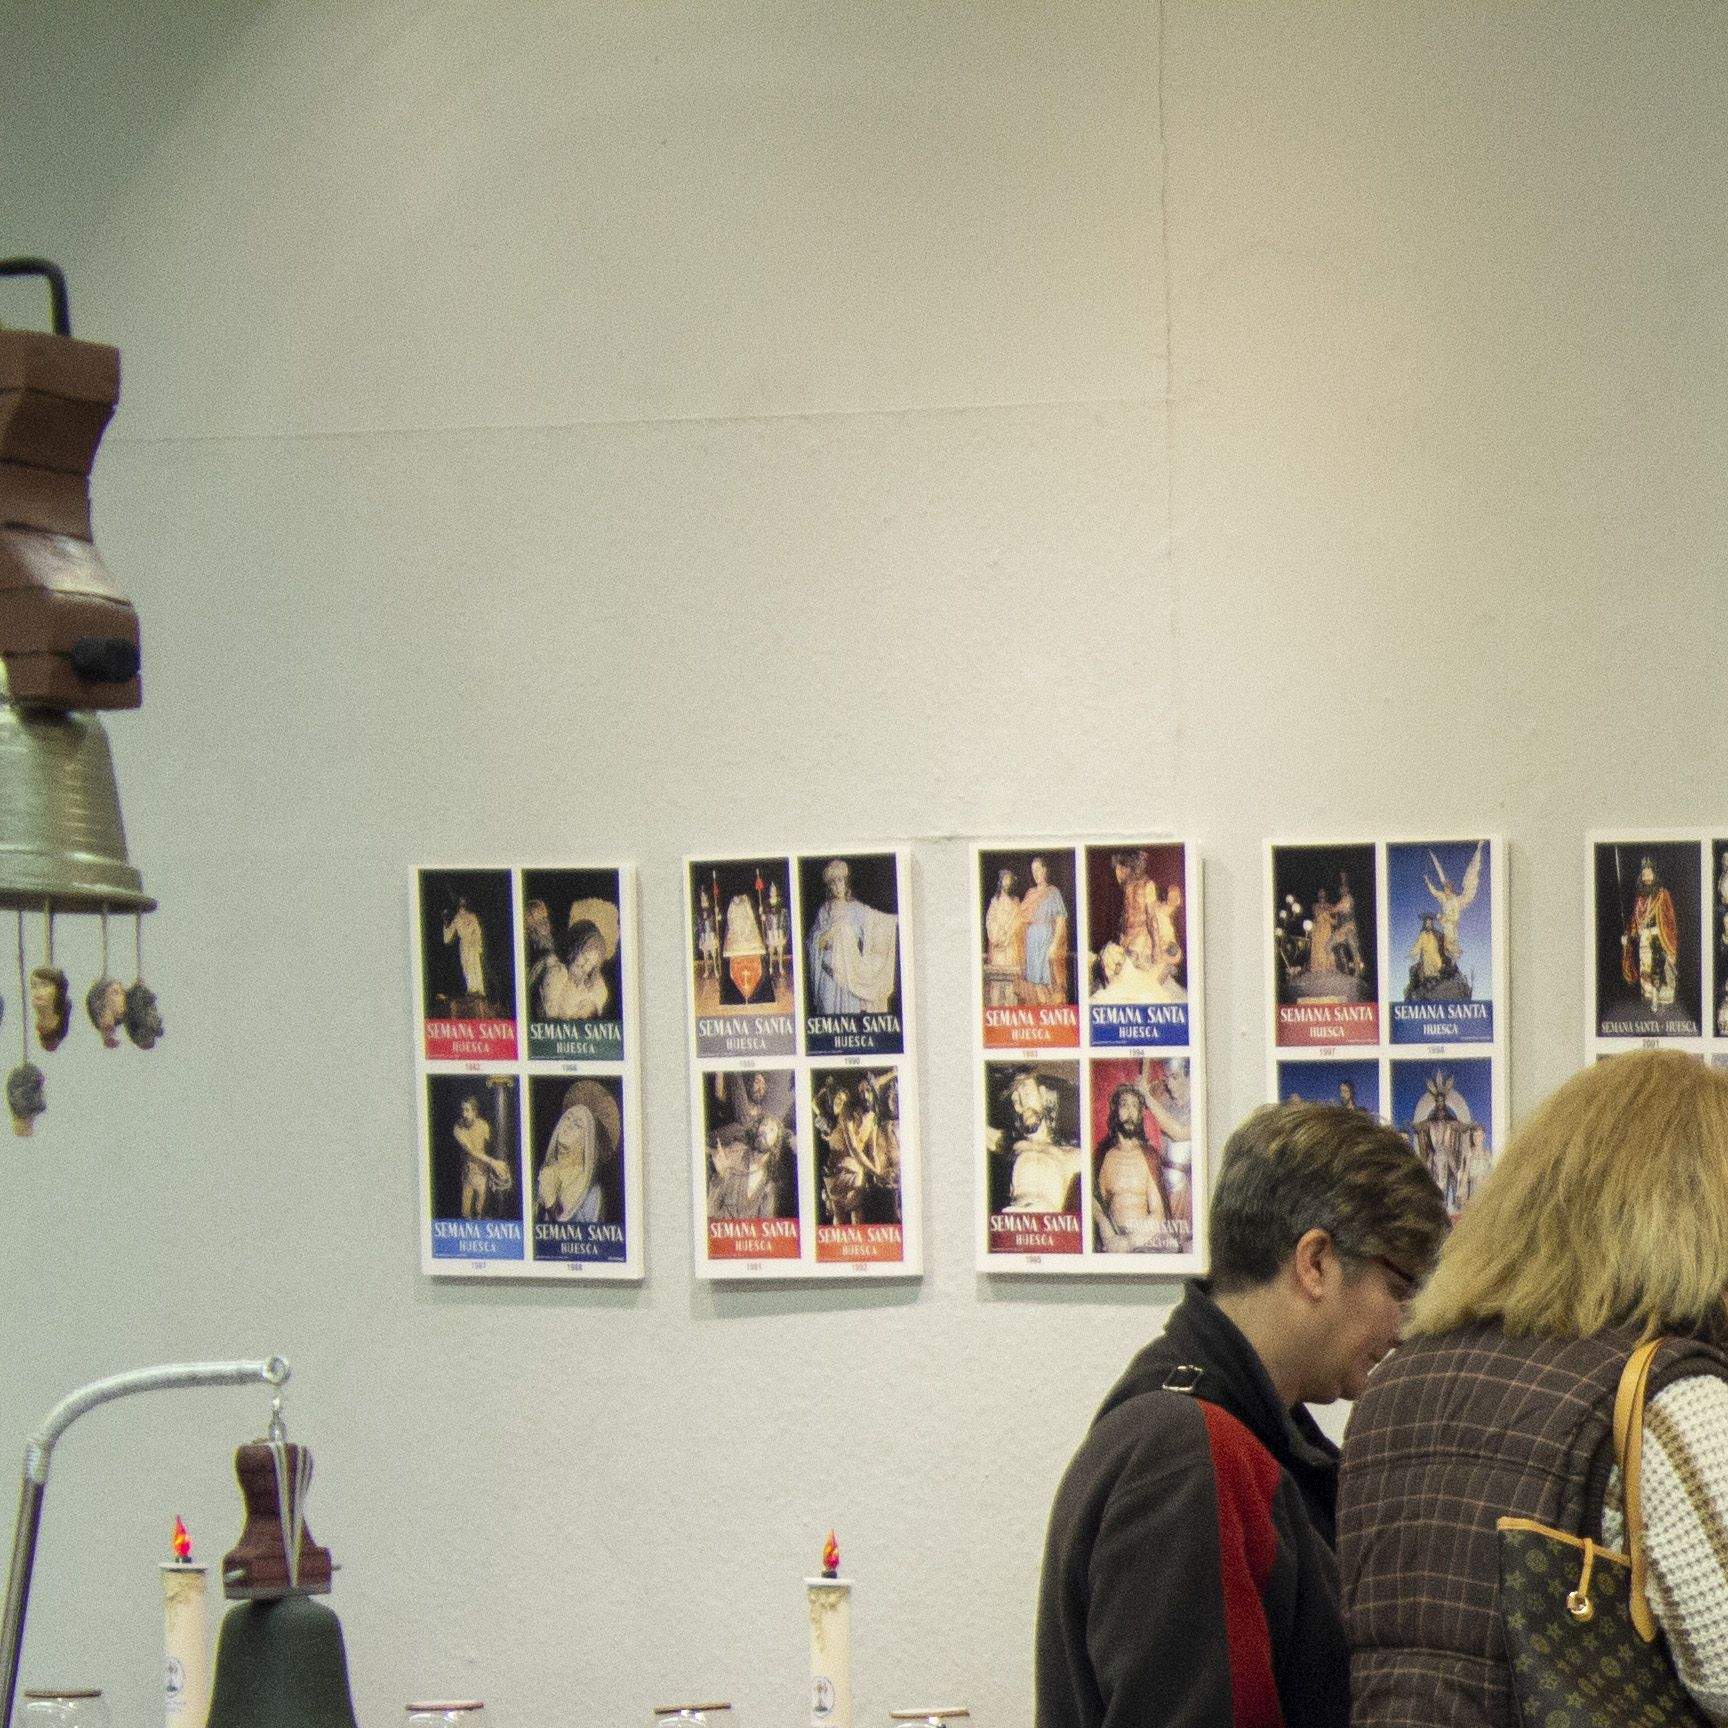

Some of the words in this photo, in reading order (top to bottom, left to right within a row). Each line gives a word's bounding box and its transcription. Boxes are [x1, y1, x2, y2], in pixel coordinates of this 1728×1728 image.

[986, 1010, 1033, 1026] SEMANA
[1040, 1009, 1076, 1025] SANTA
[1092, 1007, 1142, 1024] SEMANA
[1147, 1007, 1184, 1024] SANTA
[1280, 1006, 1331, 1022] SEMANA
[1334, 1006, 1373, 1022] SANTA
[1395, 1005, 1444, 1019] SEMANA
[1448, 1004, 1487, 1019] SANTA
[530, 1022, 577, 1040] SEMANA
[584, 1022, 620, 1040] SANTA
[700, 1018, 748, 1036] SEMANA
[755, 1017, 793, 1034] SANTA
[807, 1017, 857, 1034] SEMANA
[863, 1016, 900, 1032] SANTA
[1423, 1024, 1458, 1035] HUESCA
[1635, 1021, 1659, 1033] SANTA
[1665, 1021, 1697, 1033] HUESCA
[427, 1023, 475, 1039] SEMANA
[480, 1023, 514, 1040] SANTA
[1011, 1028, 1050, 1039] HUESCA
[1119, 1026, 1158, 1038] HUESCA
[1310, 1026, 1345, 1037] HUESCA
[726, 1038, 766, 1049] HUESCA
[834, 1035, 873, 1047] HUESCA
[452, 1042, 489, 1053] HUESCA
[556, 1042, 595, 1054] HUESCA
[710, 1222, 756, 1238] SEMANA
[763, 1221, 797, 1237] SANTA
[990, 1215, 1037, 1232] SEMANA
[1043, 1215, 1079, 1232] SANTA
[435, 1223, 480, 1239] SEMANA
[487, 1223, 520, 1239] SANTA
[535, 1225, 582, 1240] SEMANA
[588, 1225, 624, 1241] SANTA
[819, 1227, 862, 1243] SEMANA
[868, 1226, 900, 1243] SANTA
[459, 1240, 496, 1252] HUESCA
[735, 1239, 772, 1251] HUESCA
[1015, 1234, 1053, 1246] HUESCA
[561, 1242, 598, 1254] HUESCA
[842, 1245, 877, 1256] HUESCA
